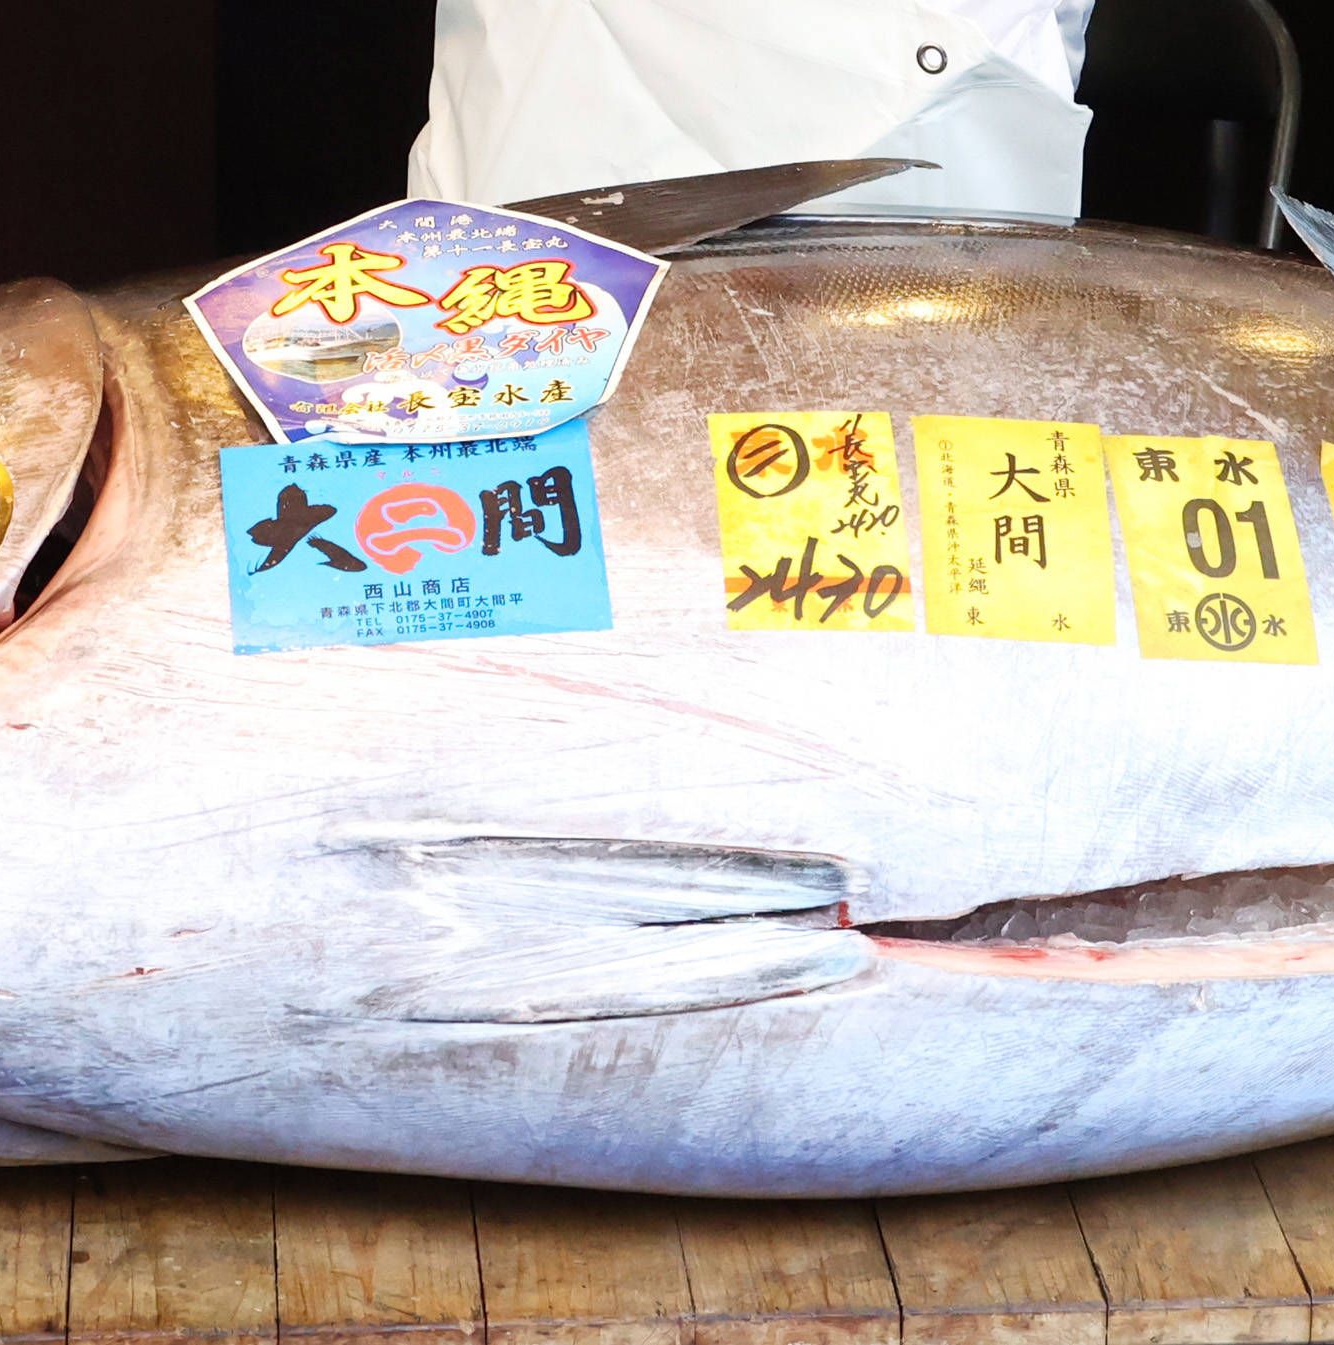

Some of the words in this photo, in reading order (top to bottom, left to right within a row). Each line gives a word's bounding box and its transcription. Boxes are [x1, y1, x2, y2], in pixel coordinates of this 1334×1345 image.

[271, 240, 598, 337] 本縄
[397, 380, 576, 415] 長宝水産
[278, 448, 386, 474] 青森県産
[402, 435, 538, 463] 本州最北端
[1046, 430, 1076, 499] 青森県
[989, 452, 1051, 570] 大間
[1181, 498, 1281, 580] 01
[363, 577, 471, 599] 西山商店
[356, 617, 383, 627] TEL
[357, 627, 385, 639] FAX
